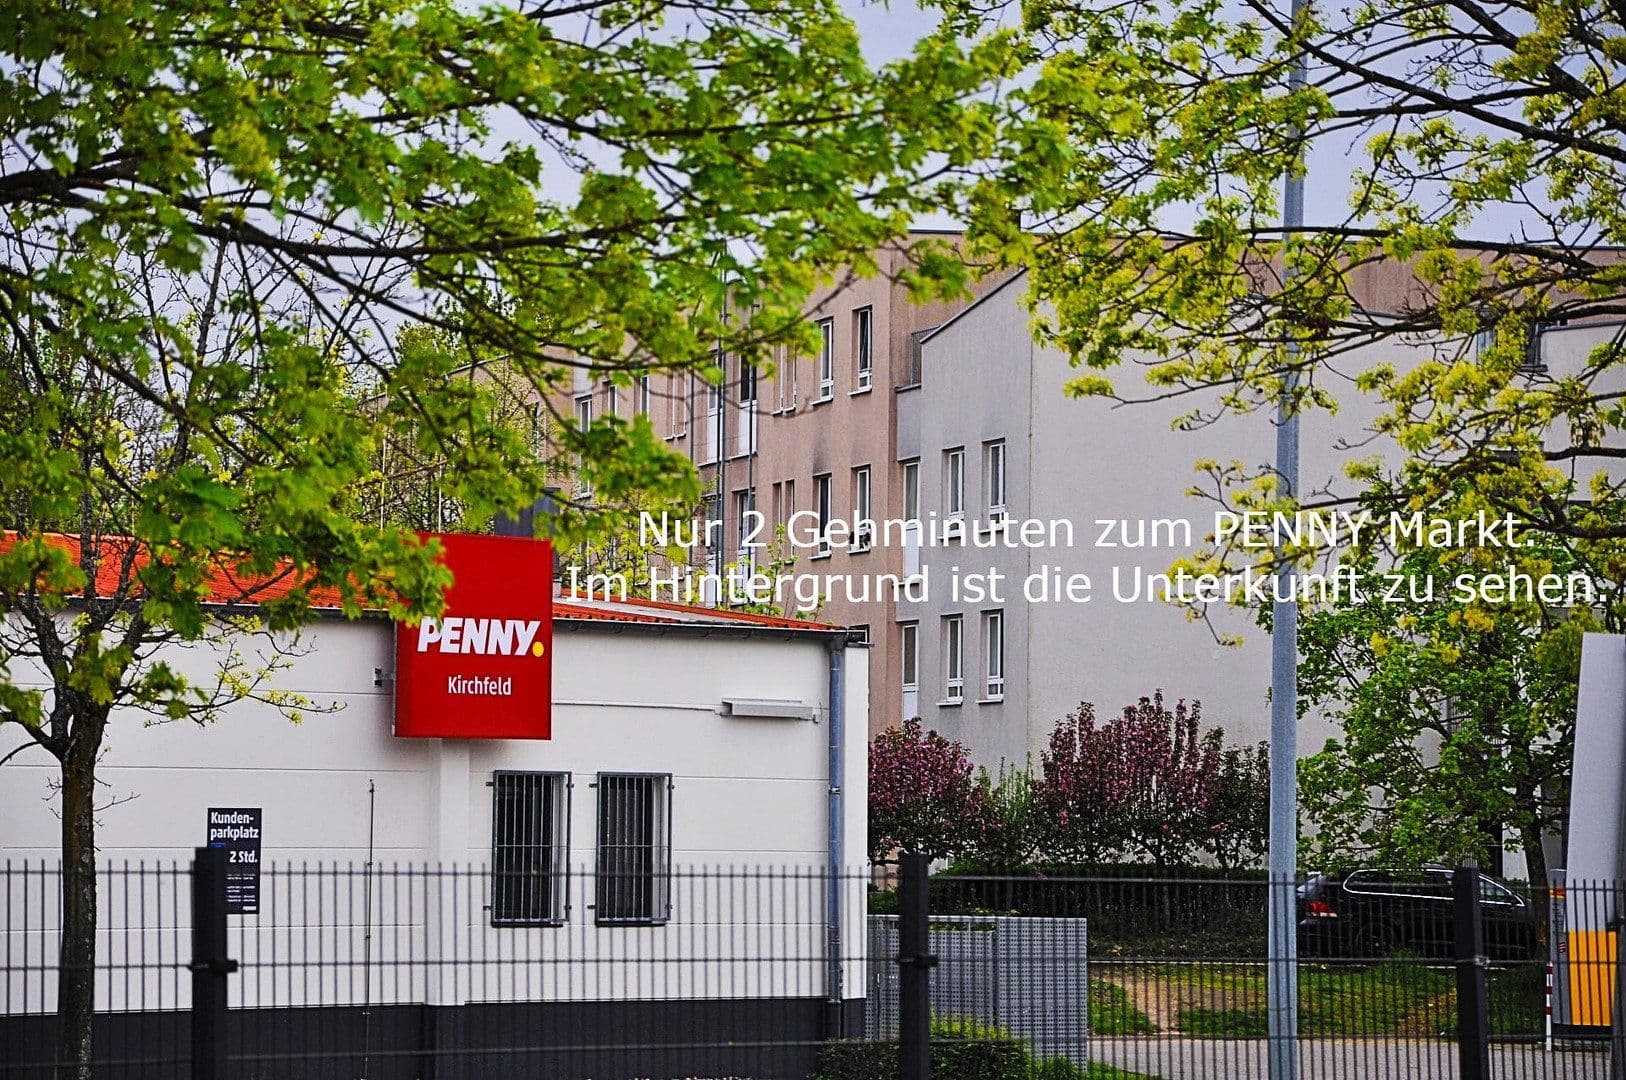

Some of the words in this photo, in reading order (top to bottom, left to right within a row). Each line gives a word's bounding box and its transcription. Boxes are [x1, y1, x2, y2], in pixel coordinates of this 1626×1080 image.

[448, 675, 512, 695] Kirchfeld
[211, 811, 254, 824] Kunden-
[210, 826, 259, 841] parkplatz
[229, 850, 237, 863] 2
[238, 850, 258, 863] Std.
